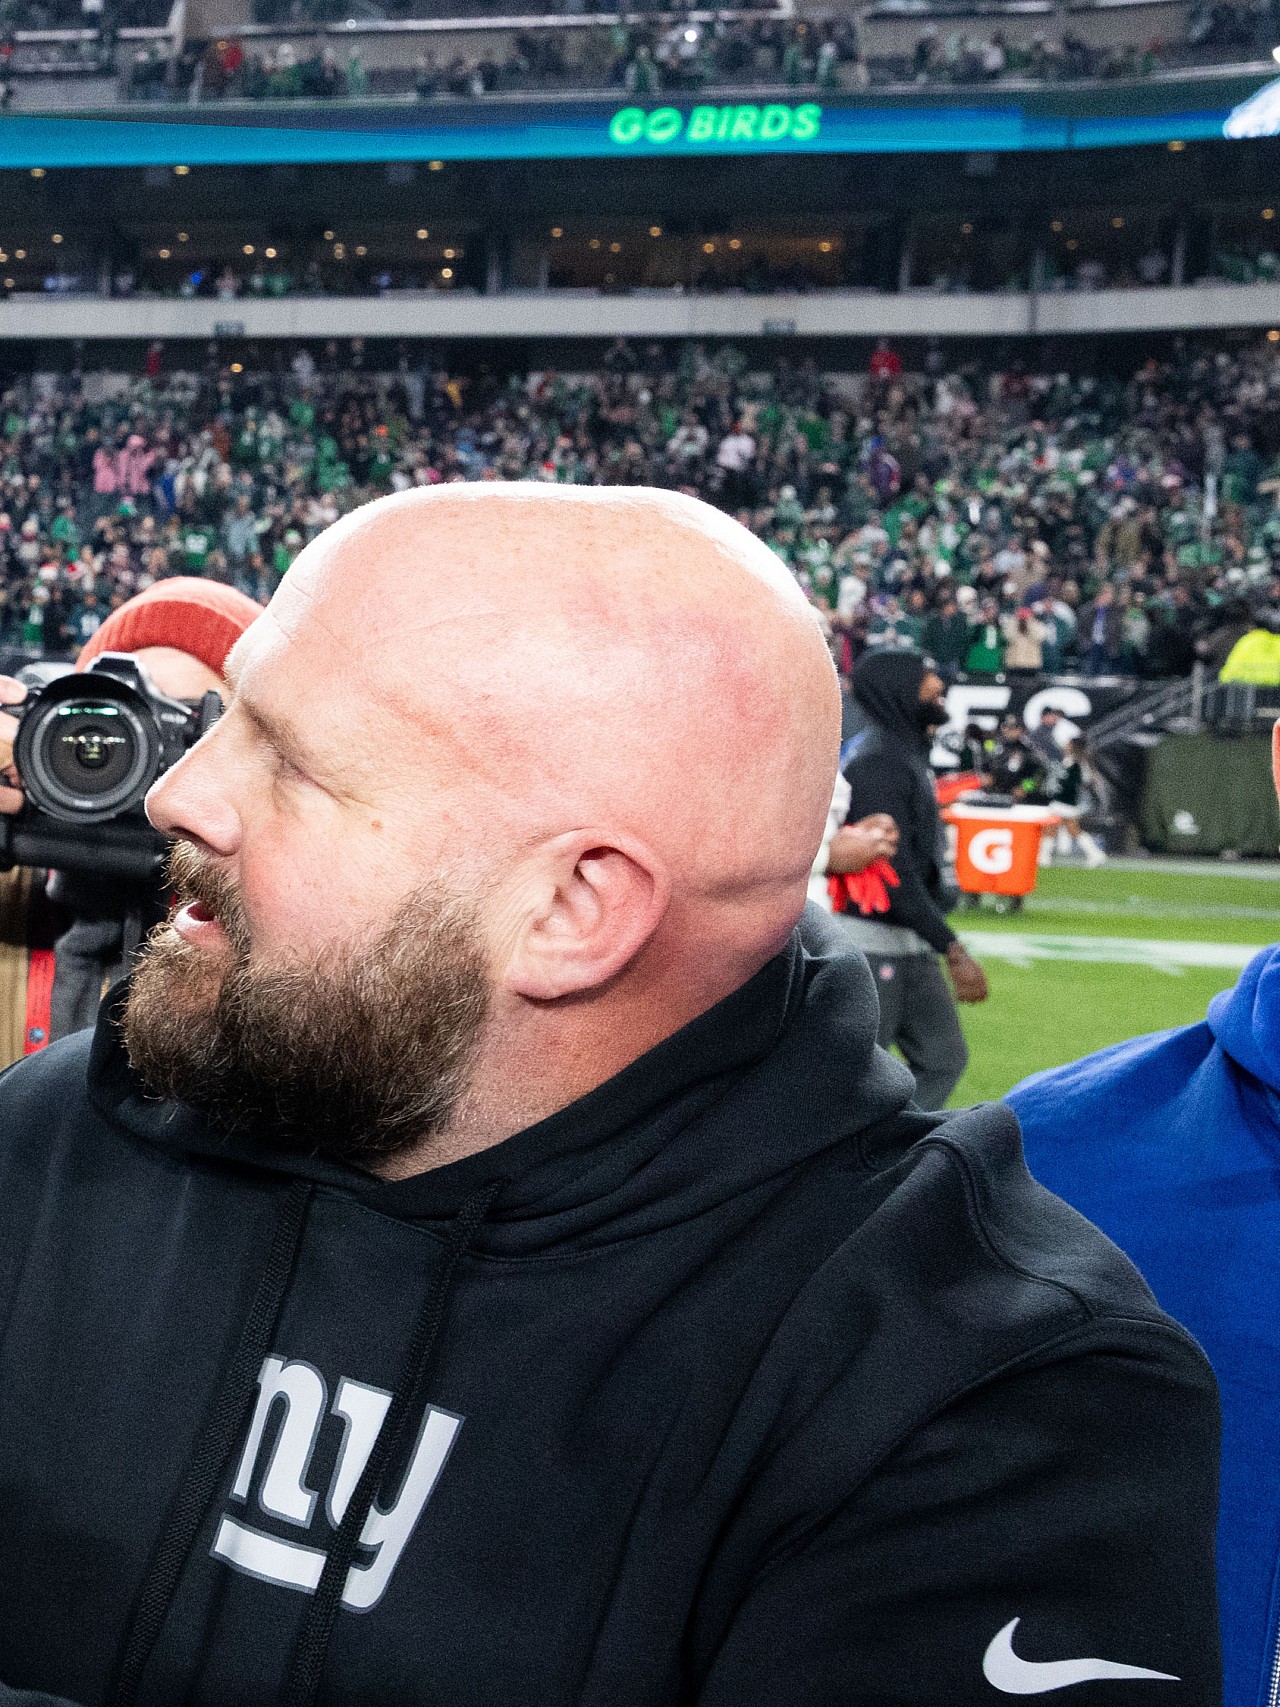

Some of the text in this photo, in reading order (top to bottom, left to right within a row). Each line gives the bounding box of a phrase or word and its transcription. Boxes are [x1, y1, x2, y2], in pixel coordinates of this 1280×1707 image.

[609, 103, 822, 144] GO BIRDS
[968, 828, 1014, 874] G
